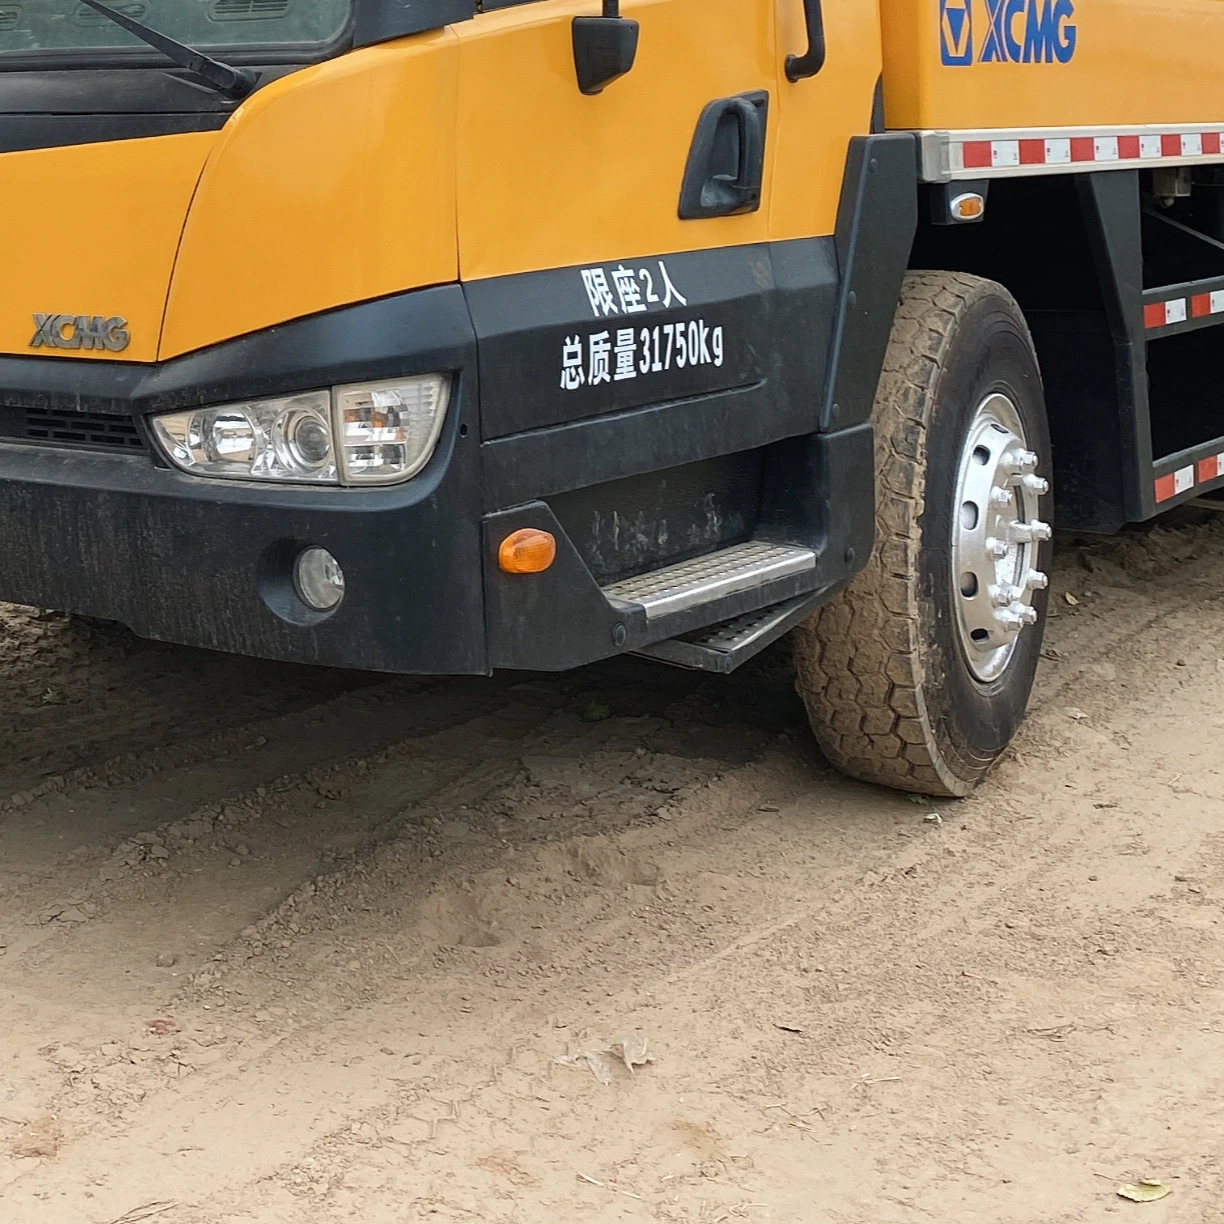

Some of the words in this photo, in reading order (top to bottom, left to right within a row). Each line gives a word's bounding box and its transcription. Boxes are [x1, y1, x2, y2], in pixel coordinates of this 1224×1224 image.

[580, 260, 687, 317] 限座2人
[28, 312, 131, 352] XCMG
[560, 319, 724, 390] 总质量31750kg
